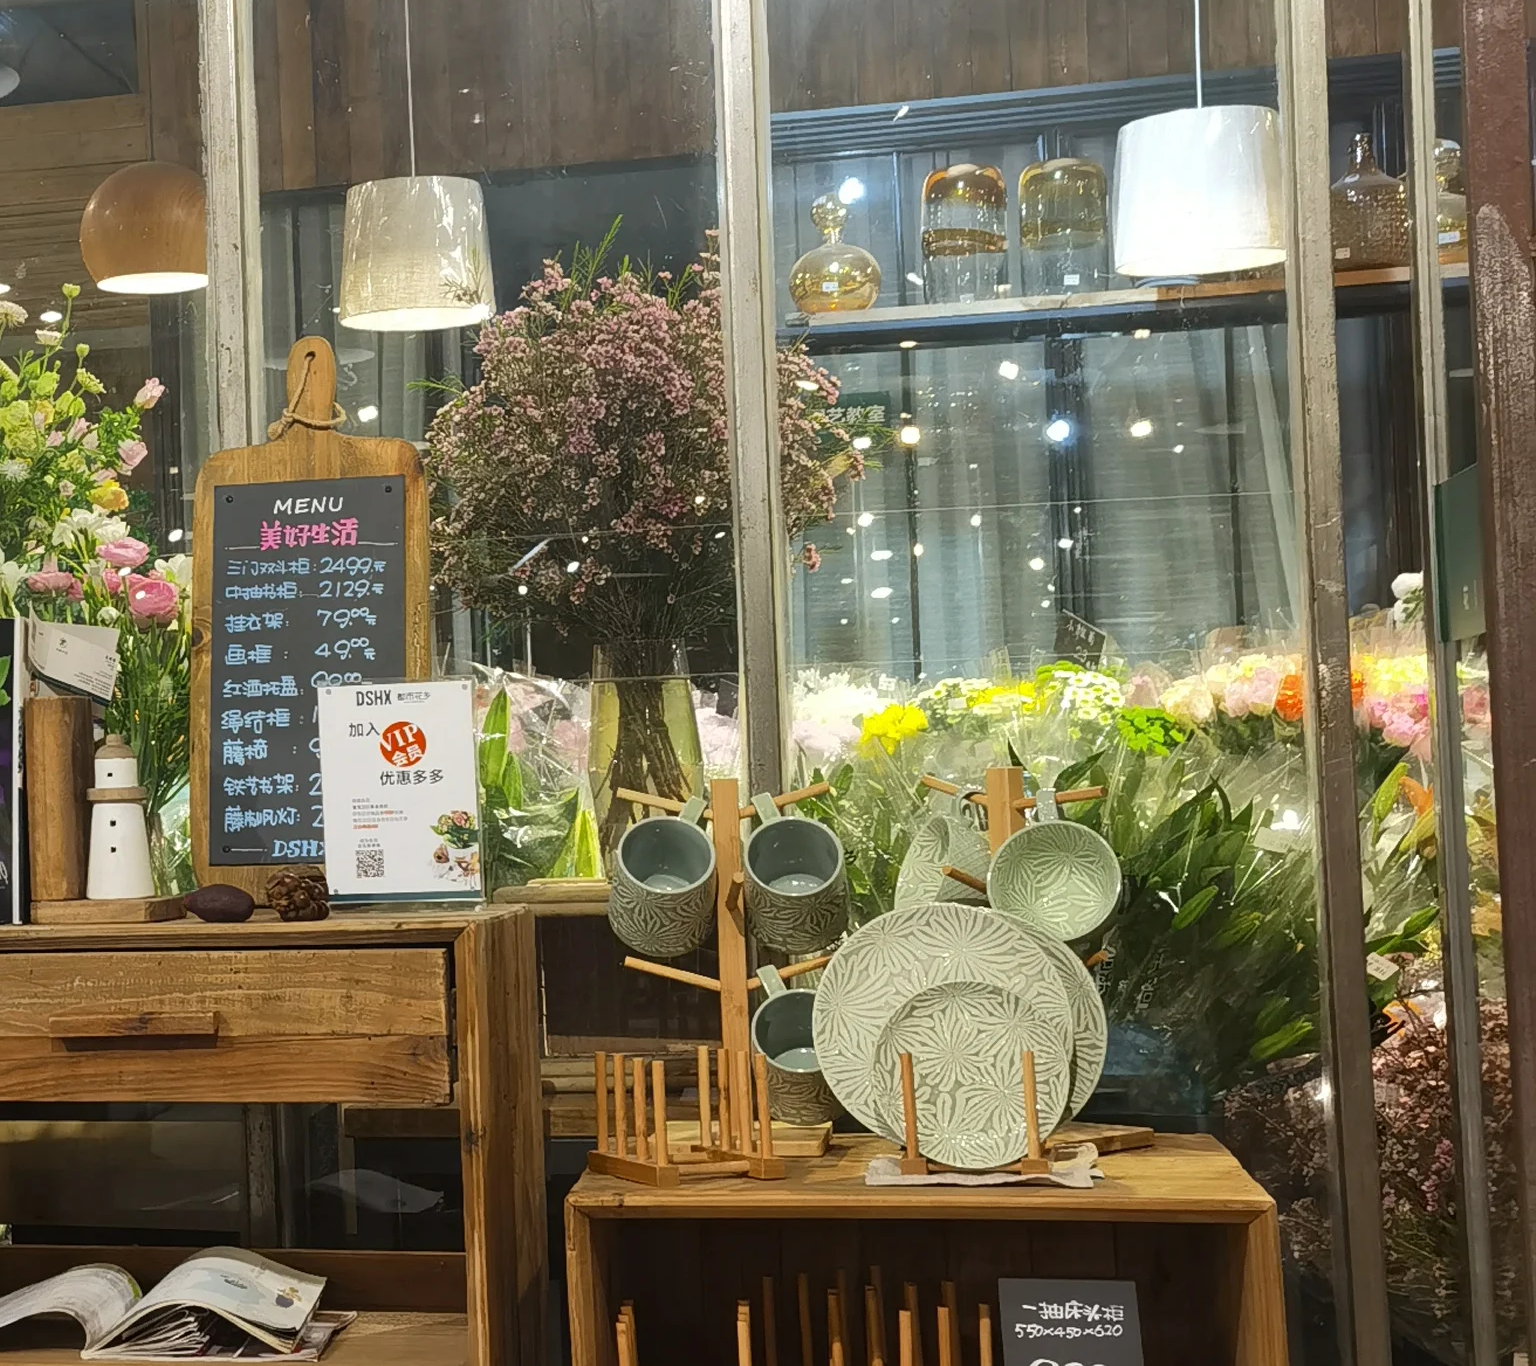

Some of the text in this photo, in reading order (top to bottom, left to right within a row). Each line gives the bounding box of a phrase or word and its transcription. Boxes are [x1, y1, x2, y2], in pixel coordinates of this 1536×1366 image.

[810, 404, 886, 425] 艺教室
[273, 496, 344, 515] MENU
[260, 518, 359, 551] 美好生活
[356, 690, 392, 707] DSHX
[348, 722, 418, 753] 加入 VIP
[391, 743, 424, 767] 会员
[380, 768, 444, 786] 优惠多多
[1021, 1300, 1124, 1322] 一抽床头柜
